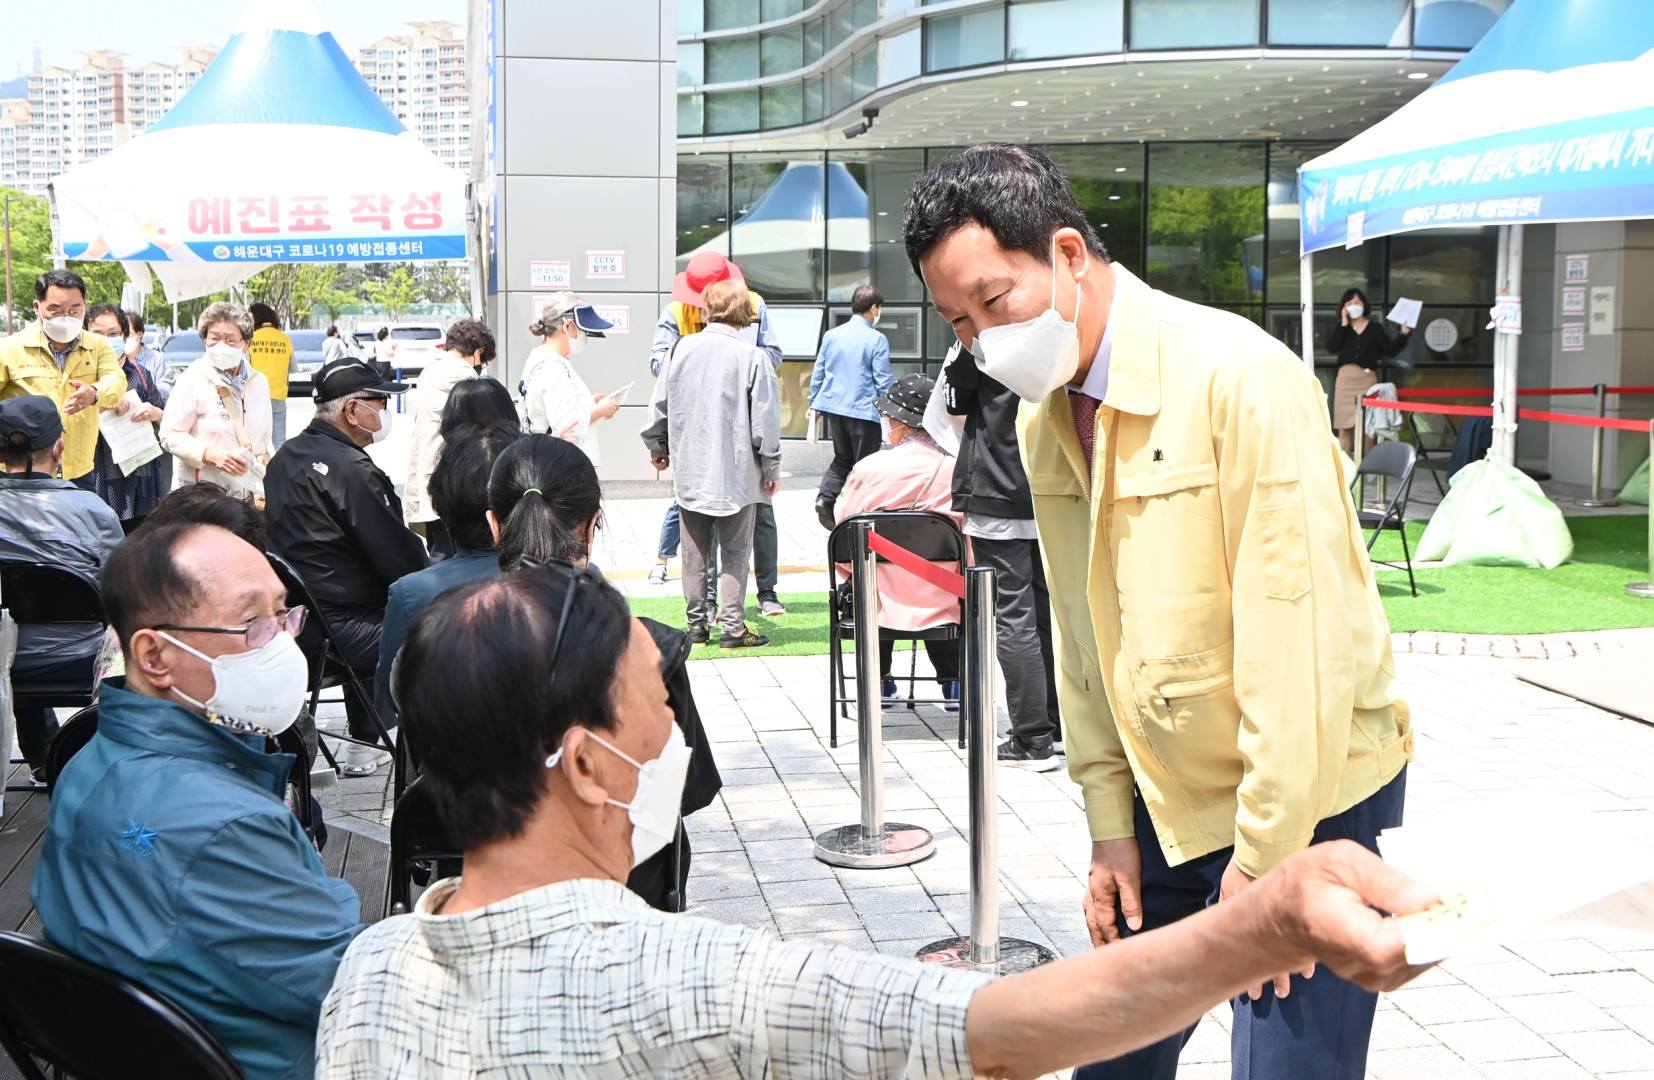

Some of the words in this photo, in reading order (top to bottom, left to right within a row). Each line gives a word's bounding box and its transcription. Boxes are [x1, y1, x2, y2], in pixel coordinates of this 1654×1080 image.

[188, 196, 332, 235] 예진표
[349, 191, 443, 231] 작성
[233, 245, 285, 259] 해운대구
[347, 241, 423, 257] 예방접종센터
[594, 256, 615, 264] CCTV
